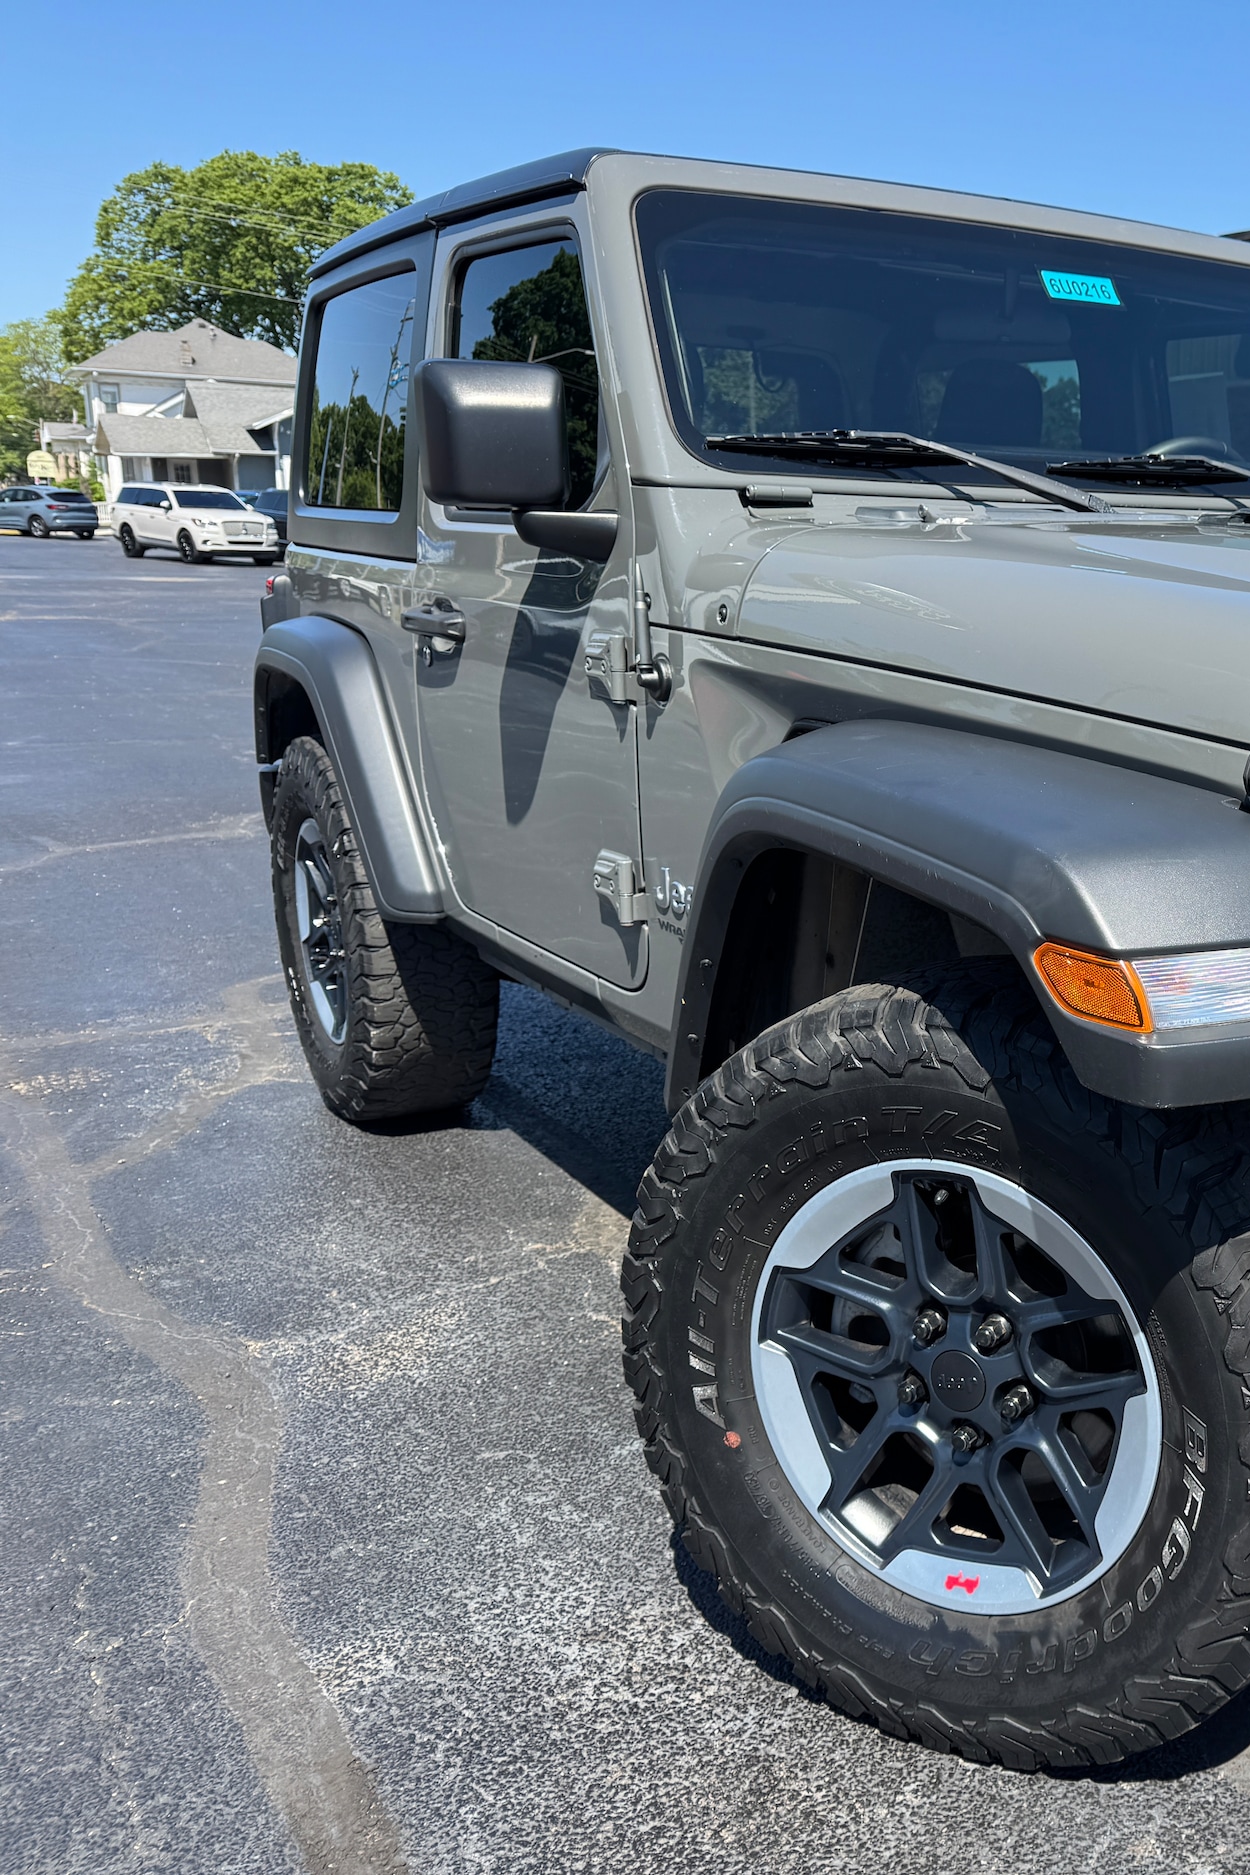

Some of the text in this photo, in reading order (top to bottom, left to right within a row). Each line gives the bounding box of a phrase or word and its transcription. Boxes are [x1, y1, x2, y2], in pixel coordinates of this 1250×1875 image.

[1049, 278, 1111, 299] 6U0216
[657, 918, 687, 936] WRA
[880, 1105, 1002, 1152] T/A
[908, 1404, 1208, 1684] BFGoodrich
